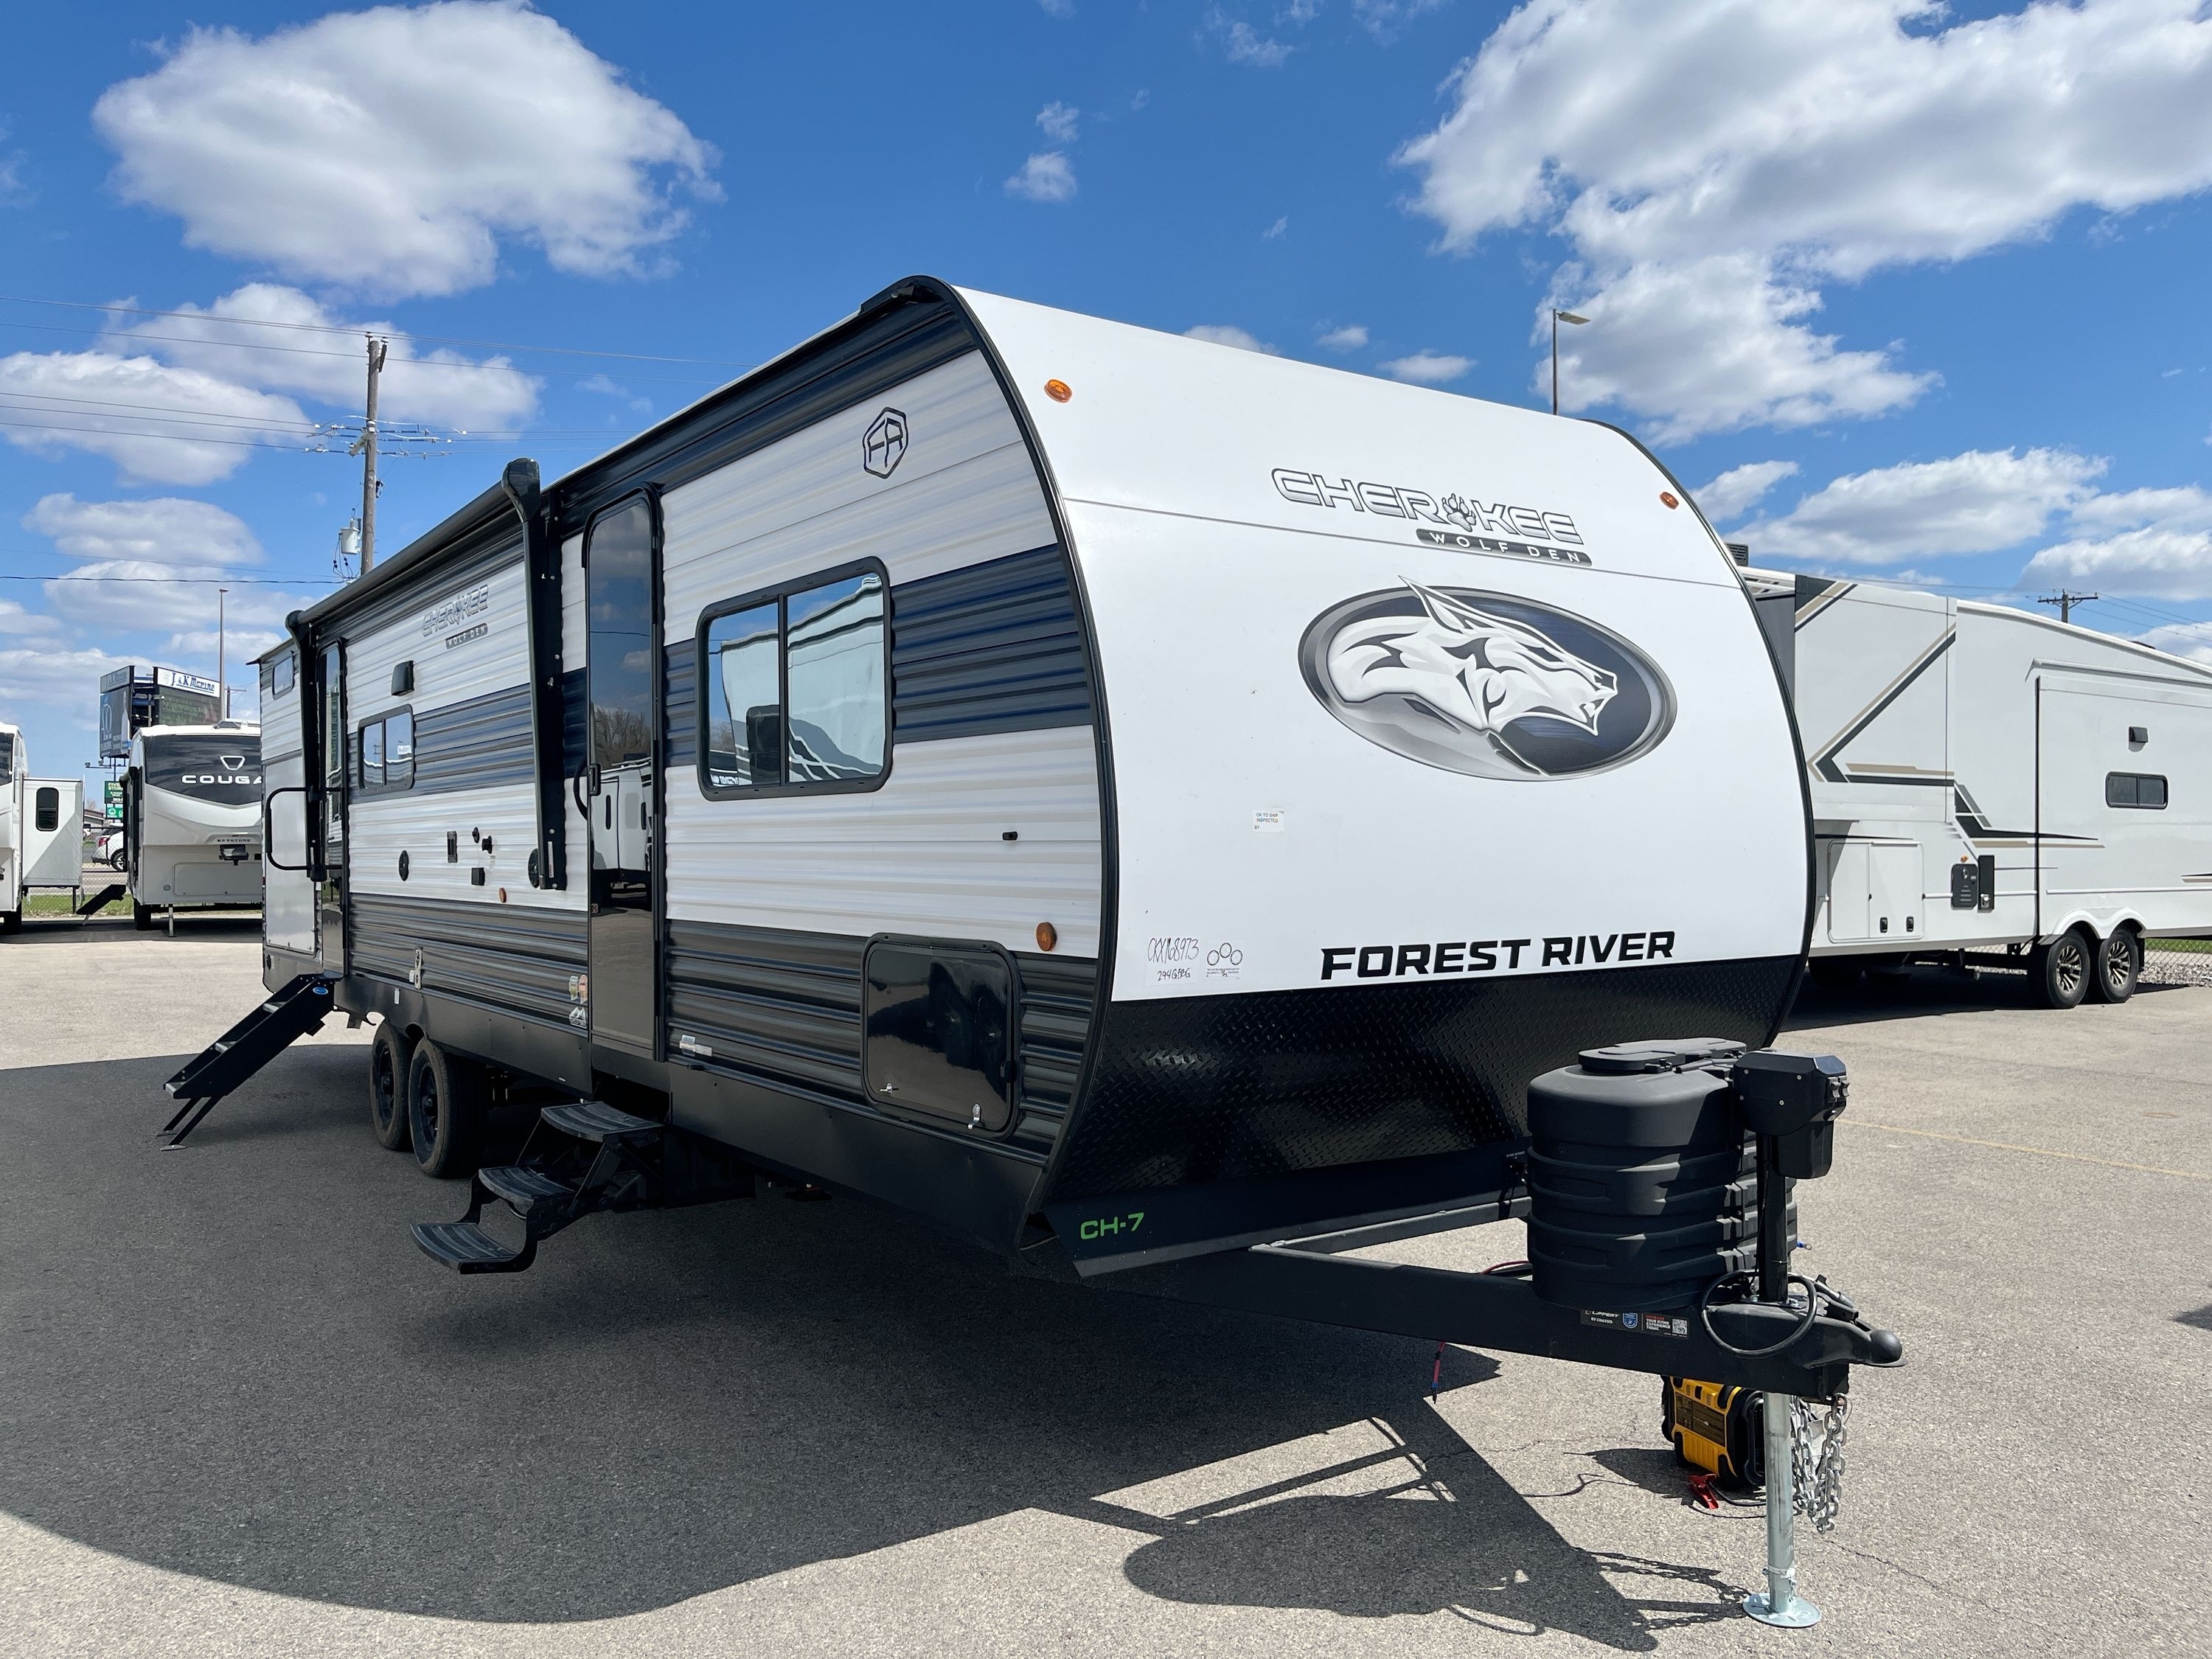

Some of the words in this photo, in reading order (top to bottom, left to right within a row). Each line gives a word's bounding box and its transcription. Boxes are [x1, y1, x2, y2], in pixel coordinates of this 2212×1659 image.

[1270, 467, 1585, 546] CHEROKEE
[1429, 532, 1509, 554] WOLF
[1526, 546, 1581, 564] DEN
[448, 633, 467, 646] WOLF
[470, 625, 486, 639] DEN
[171, 672, 176, 686] J
[183, 675, 189, 686] K
[189, 677, 215, 692] Marine
[1321, 938, 1531, 981] FOREST
[1541, 931, 1676, 967] RIVER
[1080, 1211, 1144, 1240] CH-7
[1591, 1310, 1621, 1318] LIPPERT
